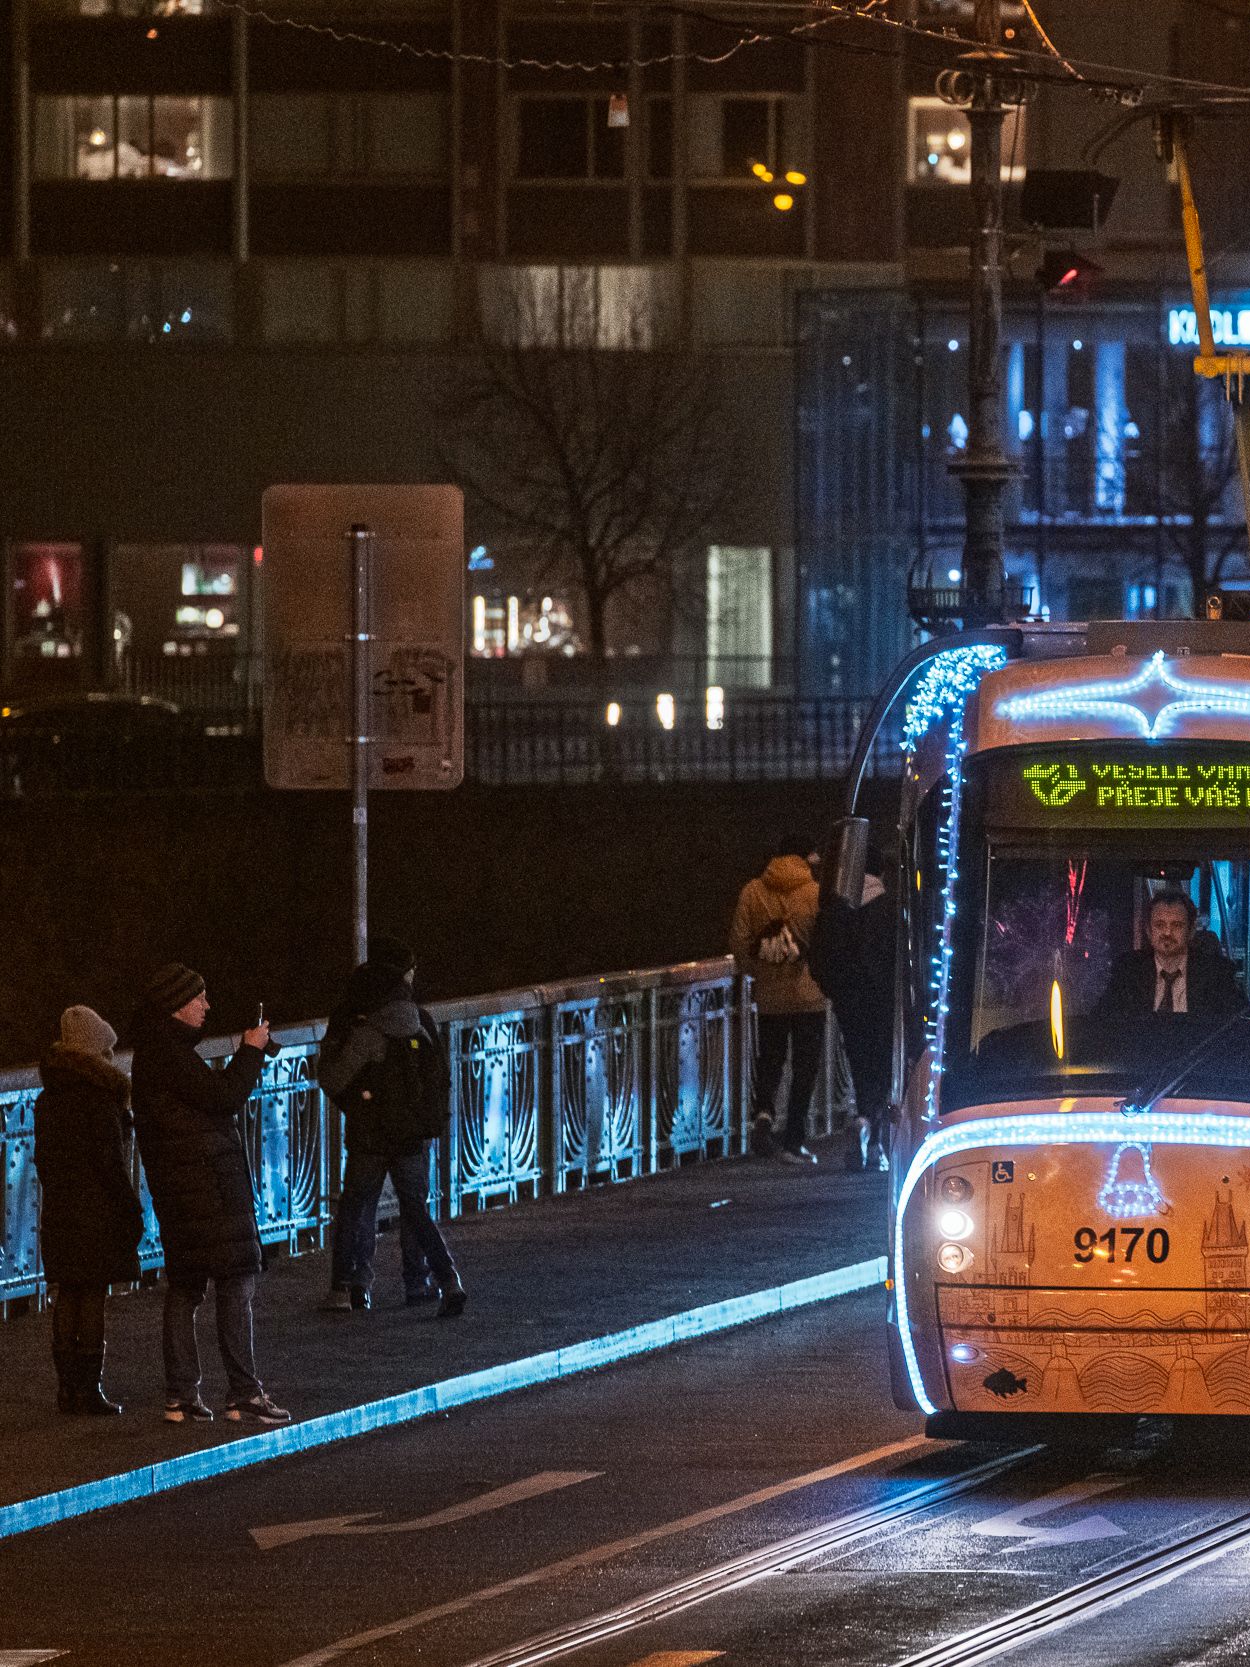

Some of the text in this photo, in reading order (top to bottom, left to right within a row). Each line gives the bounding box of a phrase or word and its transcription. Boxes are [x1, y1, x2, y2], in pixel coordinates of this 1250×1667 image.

[1097, 781, 1180, 807] PŘEJE
[1185, 781, 1241, 807] VÁŠ
[1073, 1226, 1170, 1264] 9170
